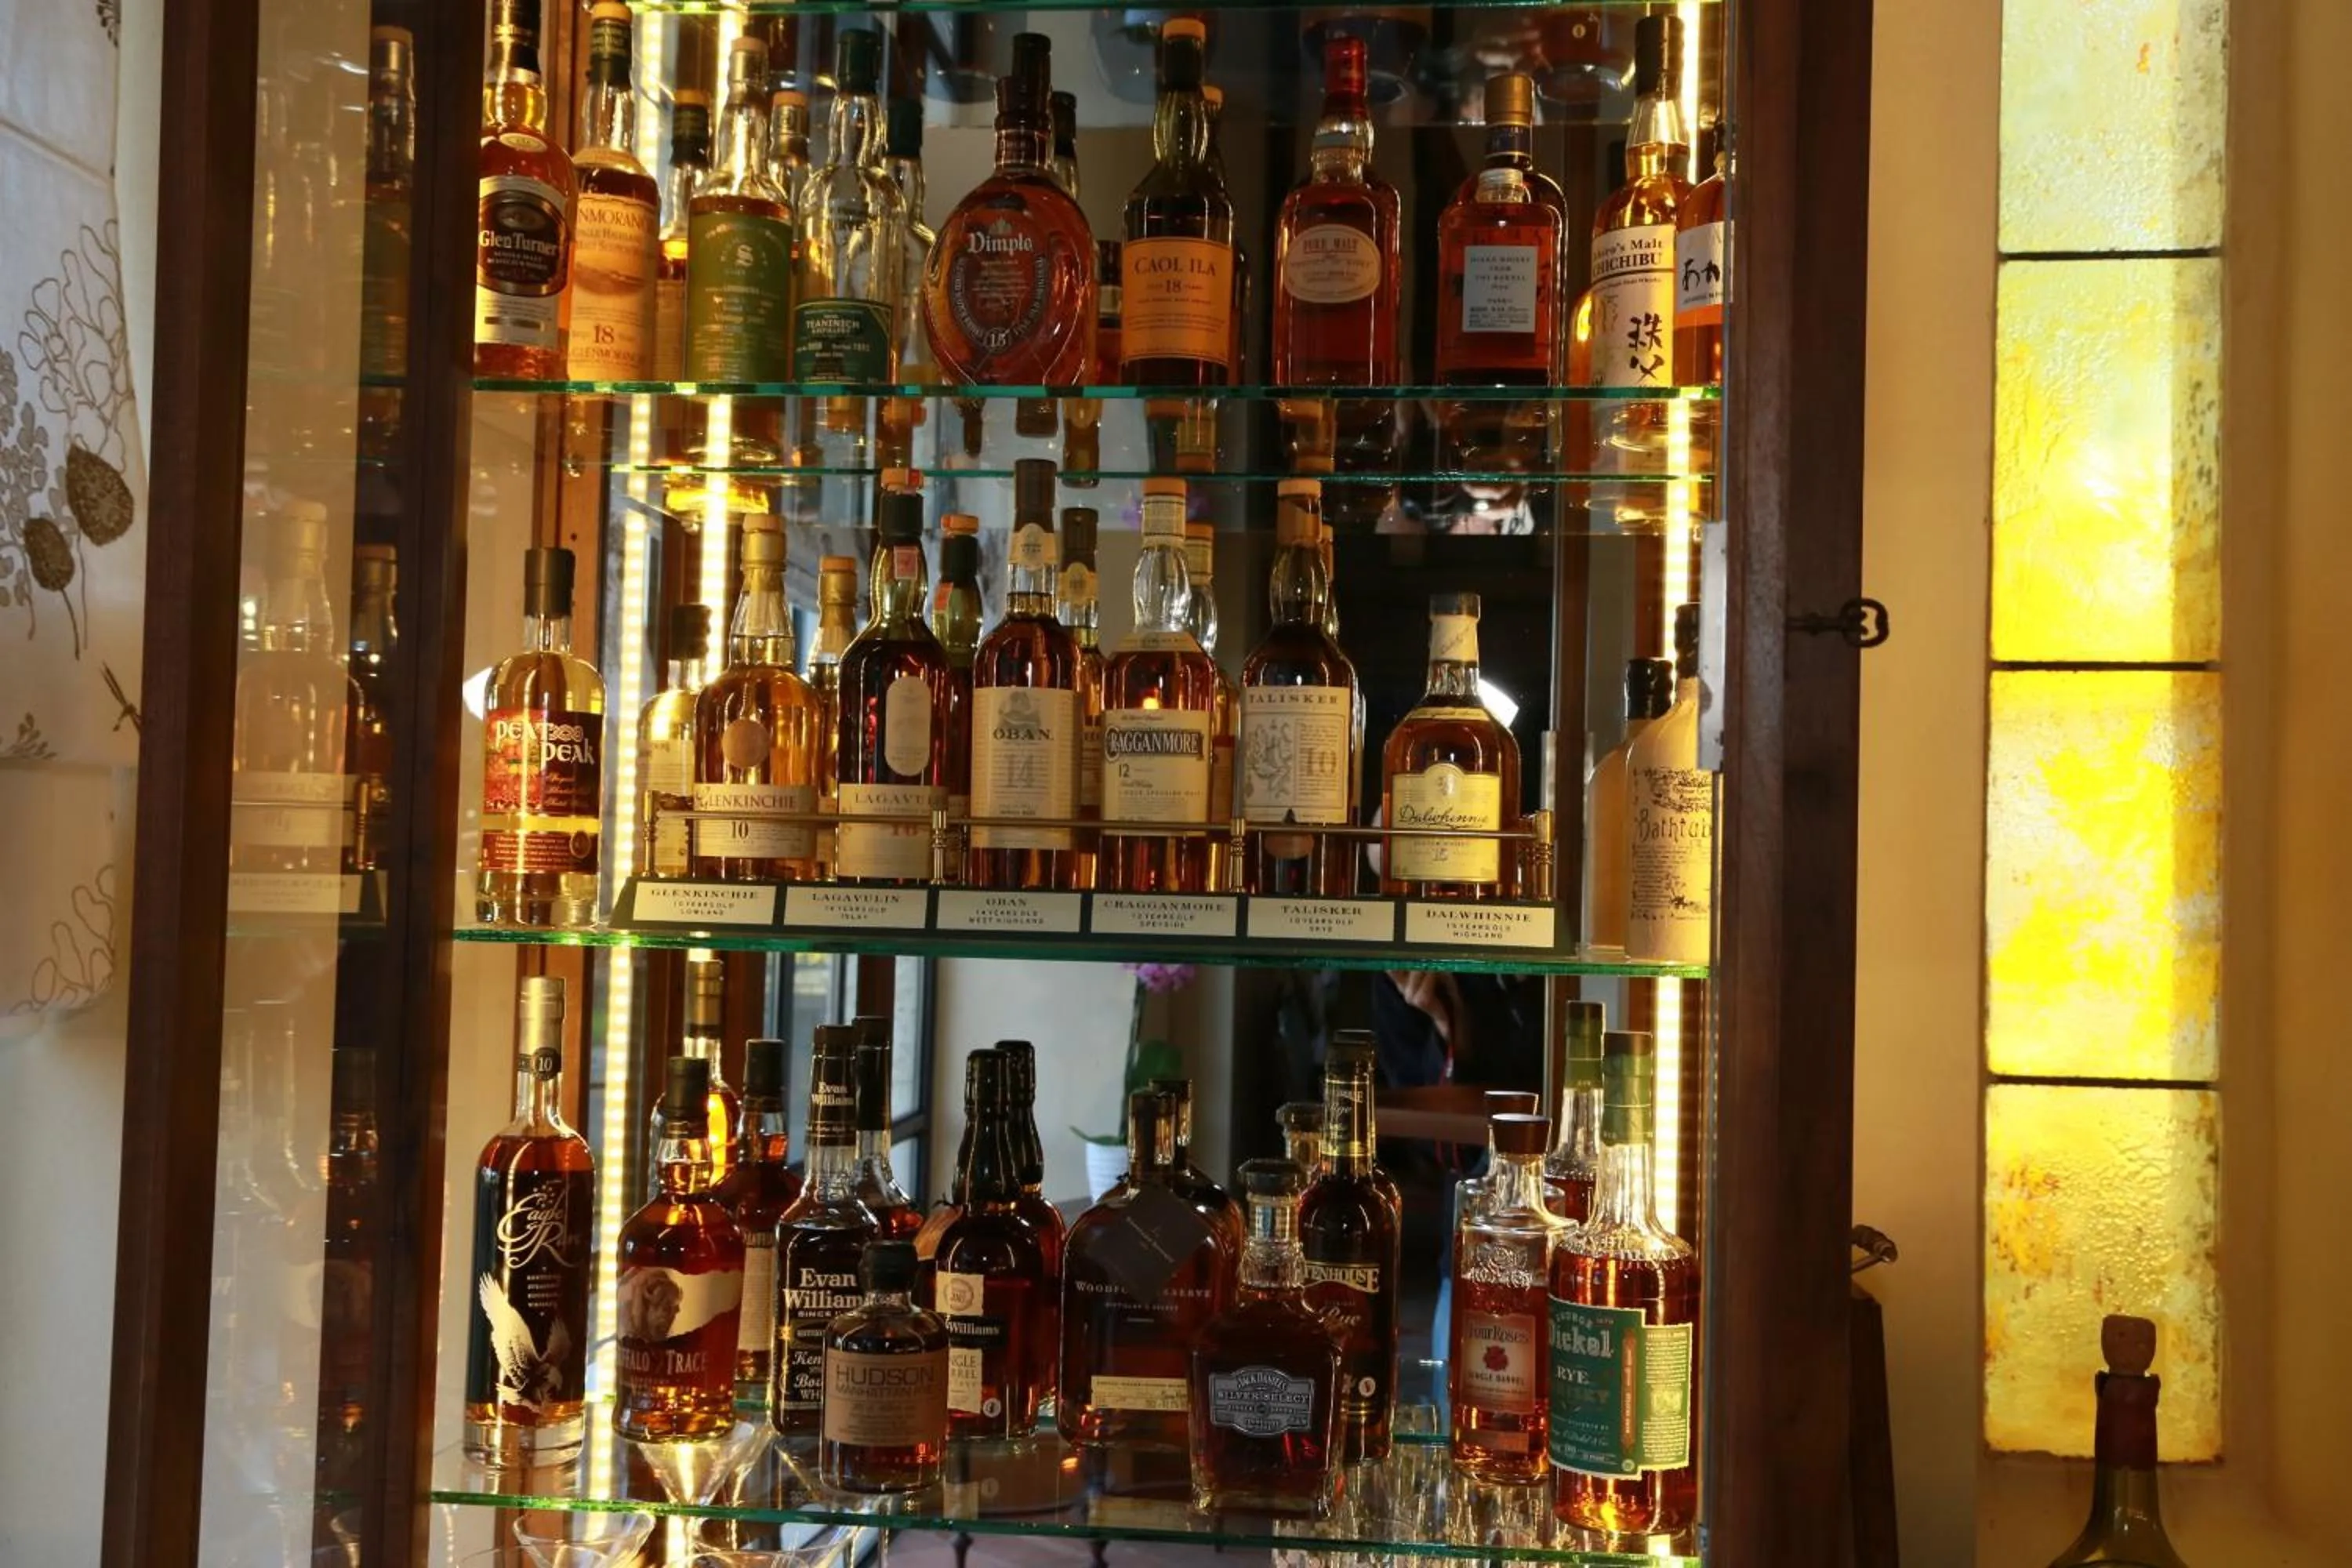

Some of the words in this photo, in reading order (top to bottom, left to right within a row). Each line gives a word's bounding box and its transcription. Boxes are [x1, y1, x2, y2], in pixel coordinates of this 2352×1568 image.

[478, 230, 512, 249] Glen
[513, 233, 557, 256] Turner
[967, 231, 1033, 256] Dimple
[1631, 238, 1662, 250] Malt
[1132, 256, 1184, 274] CAOL
[1189, 257, 1217, 277] ILA
[1166, 279, 1181, 294] 18
[594, 325, 614, 344] 18
[1250, 695, 1339, 704] TALISKER
[993, 728, 1051, 740] OBAN
[1119, 764, 1131, 778] 12
[855, 792, 931, 804] LAGAVU
[731, 821, 749, 840] 10
[652, 890, 757, 899] GLENKINCHIE
[812, 893, 900, 903] LAGAVULIN
[985, 898, 1028, 907] OBAN
[1104, 901, 1225, 912] CRAGGANMORE
[1281, 906, 1362, 916] TALISKER
[1426, 909, 1531, 923] DALWHINNIE
[539, 1056, 553, 1073] 10
[818, 1082, 848, 1094] Evan
[800, 1268, 858, 1287] Evan
[782, 1288, 867, 1309] William
[666, 1348, 707, 1376] TRACE
[836, 1364, 935, 1386] HUDSON
[1556, 1365, 1590, 1385] RYE
